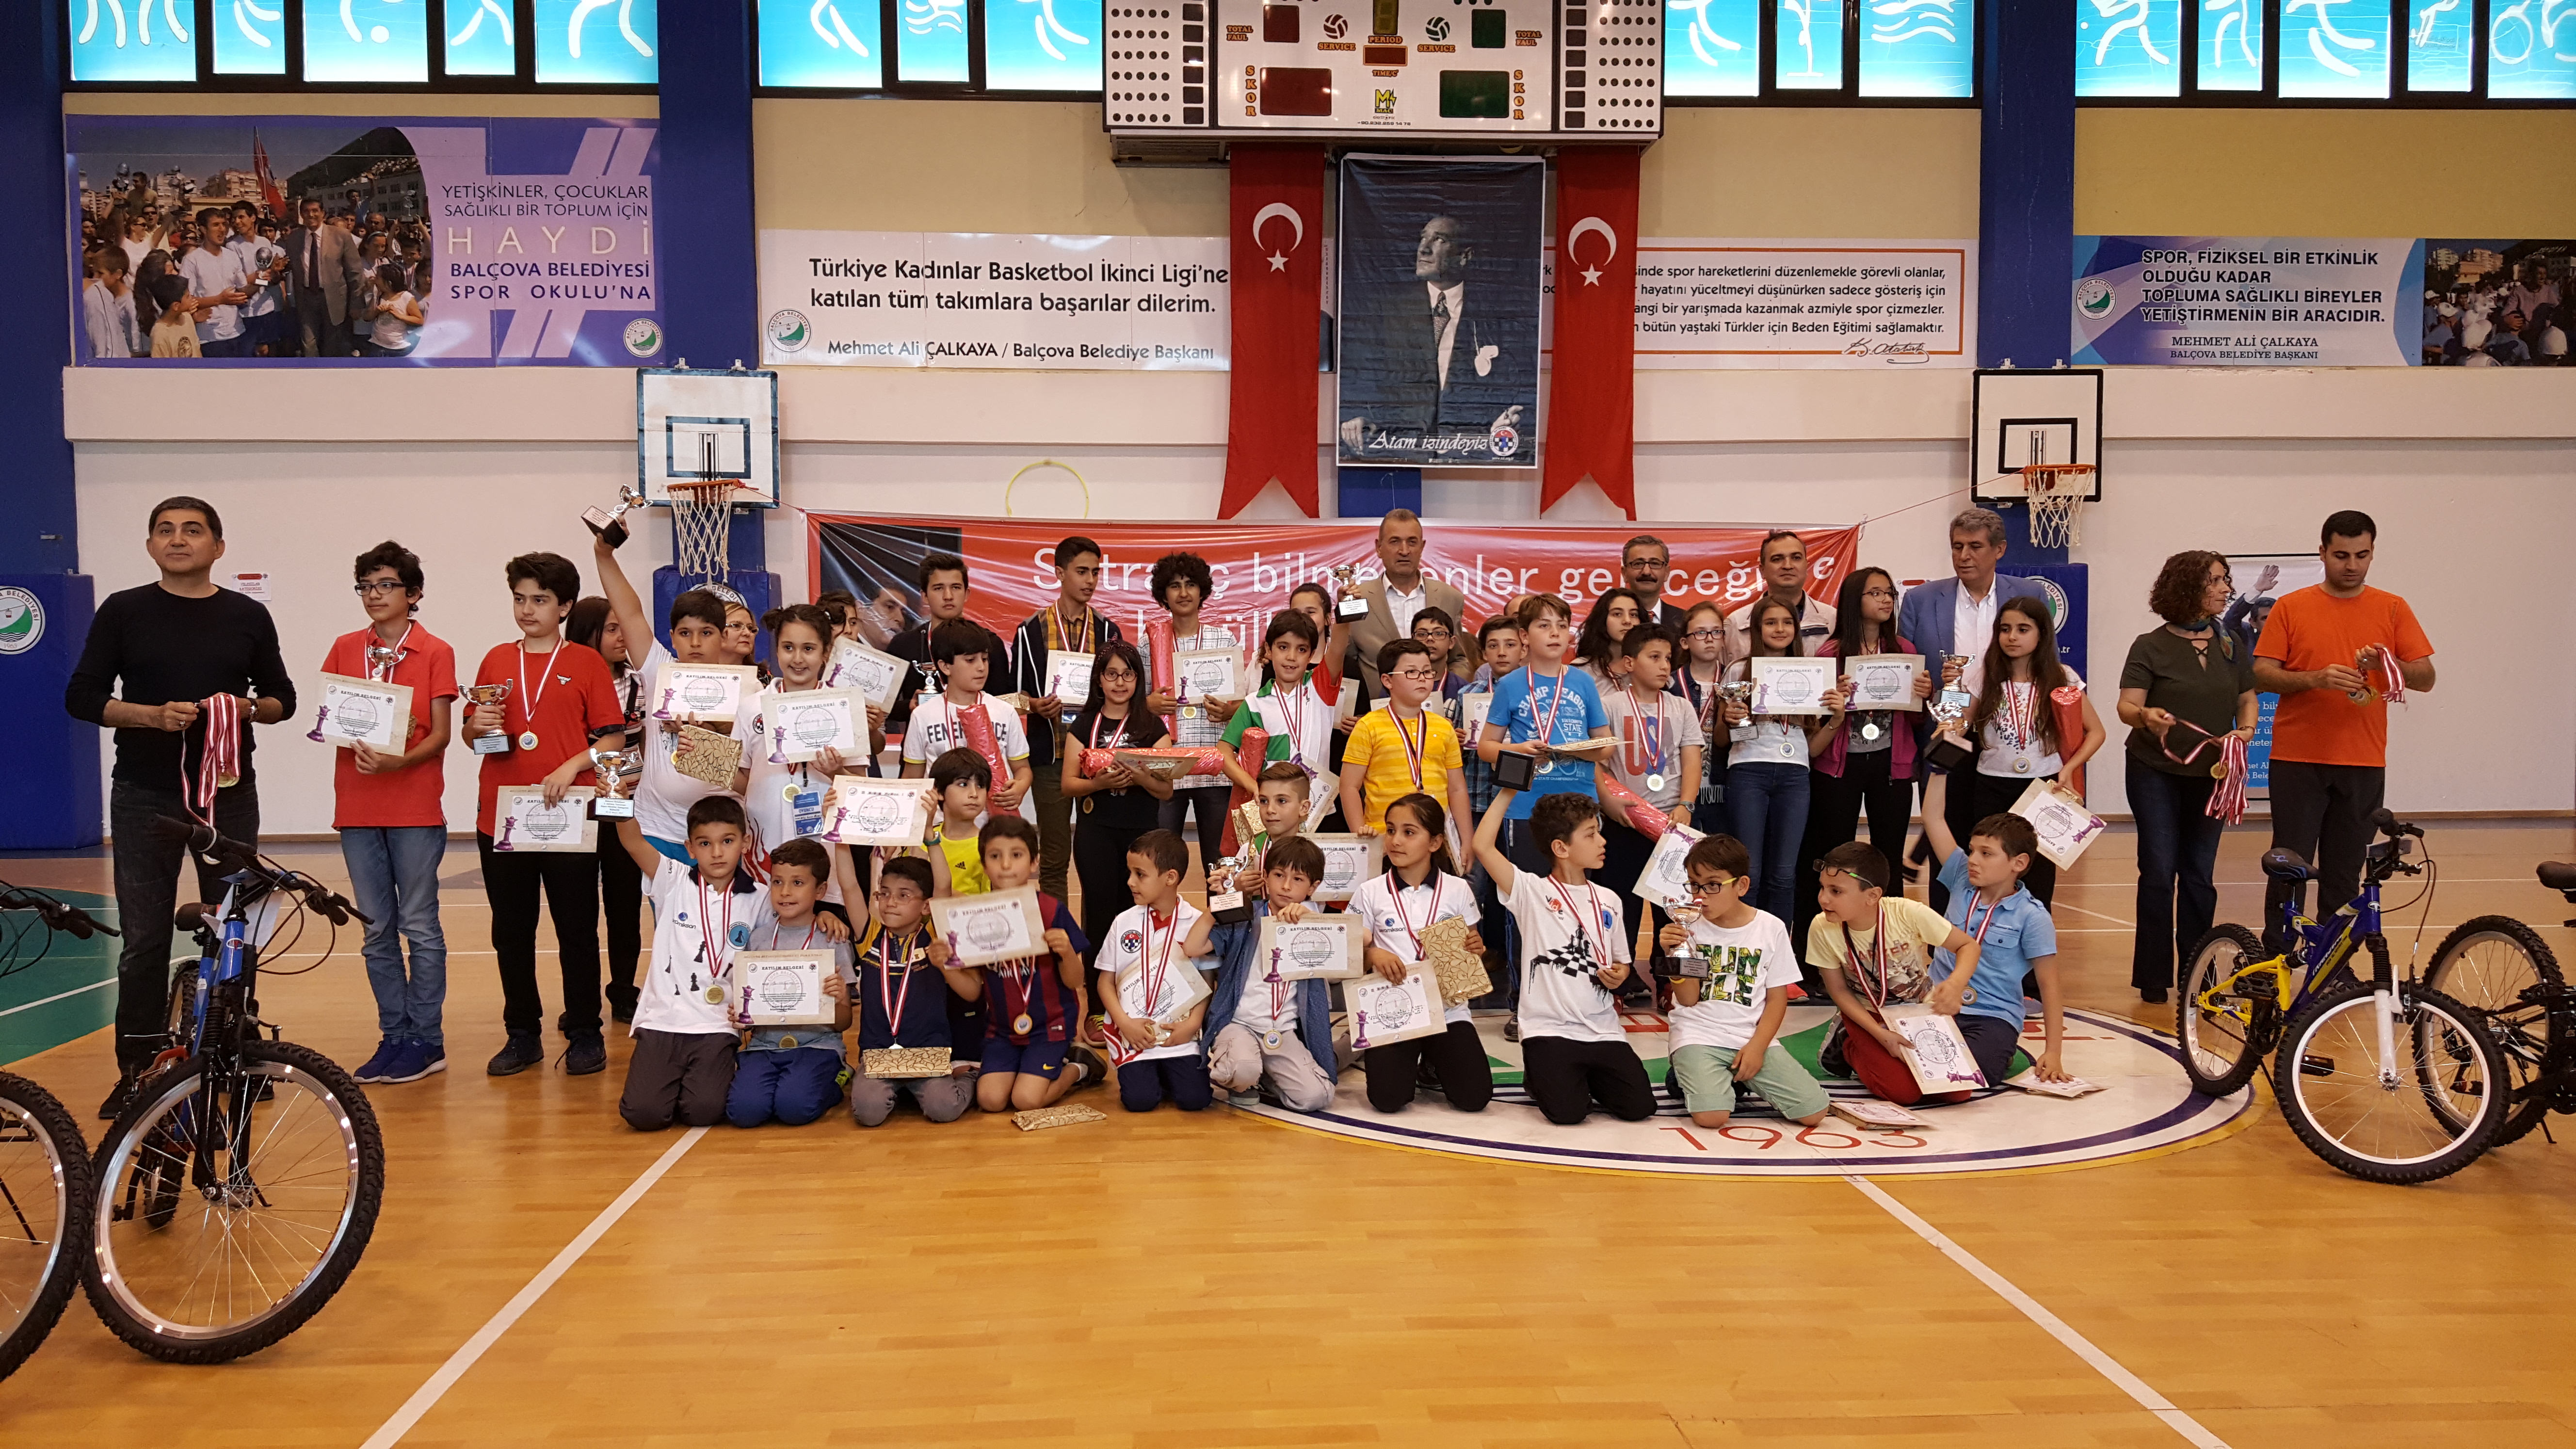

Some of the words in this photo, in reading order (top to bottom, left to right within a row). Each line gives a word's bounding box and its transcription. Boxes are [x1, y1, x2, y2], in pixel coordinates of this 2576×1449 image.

[1318, 42, 1356, 51] SERVICE
[1368, 36, 1402, 44] PERIOD
[1417, 44, 1456, 52] SERVICE
[1245, 65, 1257, 117] SKOR
[1513, 69, 1525, 120] SKOR
[441, 182, 547, 202] YETİŞKİNLER,
[554, 185, 648, 201] ÇOCUKLAR
[445, 202, 511, 217] SAĞLIKLI
[516, 201, 539, 216] BİR
[544, 204, 612, 216] TOPLUM
[617, 202, 647, 220] İÇİN
[448, 220, 648, 254] HAYDİ
[2143, 250, 2192, 266] SPOR,
[2198, 247, 2268, 265] FİZİKSEL
[2275, 247, 2301, 265] BİR
[2306, 247, 2377, 266] ETKİNLİK
[451, 262, 541, 281] BALÇOVA
[548, 259, 649, 277] BELEDİYESİ
[808, 258, 887, 282] Türkiye
[895, 259, 982, 280] Kadınlar
[989, 262, 1093, 281] Basketbol
[1101, 258, 1154, 282] İkinci
[1162, 264, 1229, 288] Ligi'ne
[1635, 265, 1664, 276] inde
[1667, 268, 1695, 278] spor
[1698, 265, 1771, 276] hareketlerini
[1774, 266, 1857, 277] düzenlemekle
[1860, 266, 1900, 280] görevli
[1904, 267, 1946, 279] olanlar,
[2142, 266, 2210, 284] OLDUĞU
[2216, 269, 2270, 284] KADAR
[451, 285, 510, 299] SPOR
[531, 285, 651, 300] OKULU'NA
[1641, 284, 1686, 297] hayatını
[1690, 284, 1754, 297] yüceltmeyi
[1757, 284, 1825, 298] düşünürken
[1829, 285, 1871, 295] sadece
[1875, 285, 1922, 298] gösteriş
[1926, 285, 1945, 299] için
[2142, 288, 2221, 303] TOPLUMA
[2225, 286, 2301, 303] SAĞLIKLI
[2305, 286, 2382, 303] BİREYLER
[811, 288, 881, 307] katılan
[888, 290, 928, 308] tüm
[935, 291, 1032, 310] takımlara
[1040, 292, 1131, 317] başarılar
[1137, 293, 1215, 312] dilerim.
[1634, 303, 1658, 317] angi
[1662, 303, 1679, 313] bir
[1681, 303, 1742, 317] yarışmada
[1746, 303, 1804, 314] kazanmak
[1807, 303, 1852, 316] azmiyle
[1856, 306, 1884, 316] spor
[1886, 303, 1945, 317] çizmezler.
[2141, 305, 2267, 325] YETİŞTİRMENİN
[2273, 305, 2299, 322] BİR
[2303, 307, 2385, 322] ARACIDIR.
[1643, 321, 1676, 332] bütün
[1679, 321, 1721, 335] yaştaki
[1724, 322, 1765, 332] Türkler
[1768, 322, 1787, 336] için
[1792, 322, 1829, 332] Beden
[1833, 322, 1871, 335] Eğitimi
[1875, 322, 1944, 335] sağlamaktır.
[2172, 336, 2231, 347] MEHMET
[2235, 334, 2256, 347] ALİ
[2260, 336, 2318, 349] ÇALKAYA
[828, 340, 893, 355] Mehmet
[898, 340, 919, 355] Ali
[925, 341, 998, 360] ÇALKAYA
[1014, 343, 1074, 361] Balçova
[1080, 344, 1149, 361] Belediye
[1155, 344, 1214, 363] Başkanı
[2170, 350, 2217, 360] BALÇOVA
[2220, 349, 2271, 359] BELEDİYE
[2275, 350, 2318, 360] BAŞKANI
[1368, 431, 1416, 449] Atam
[1422, 433, 1488, 455] izindeyiz
[1563, 723, 1582, 732] STATE
[1104, 733, 1129, 742] WAT
[1624, 716, 1677, 776] USA
[1659, 1126, 1928, 1150] 1963
